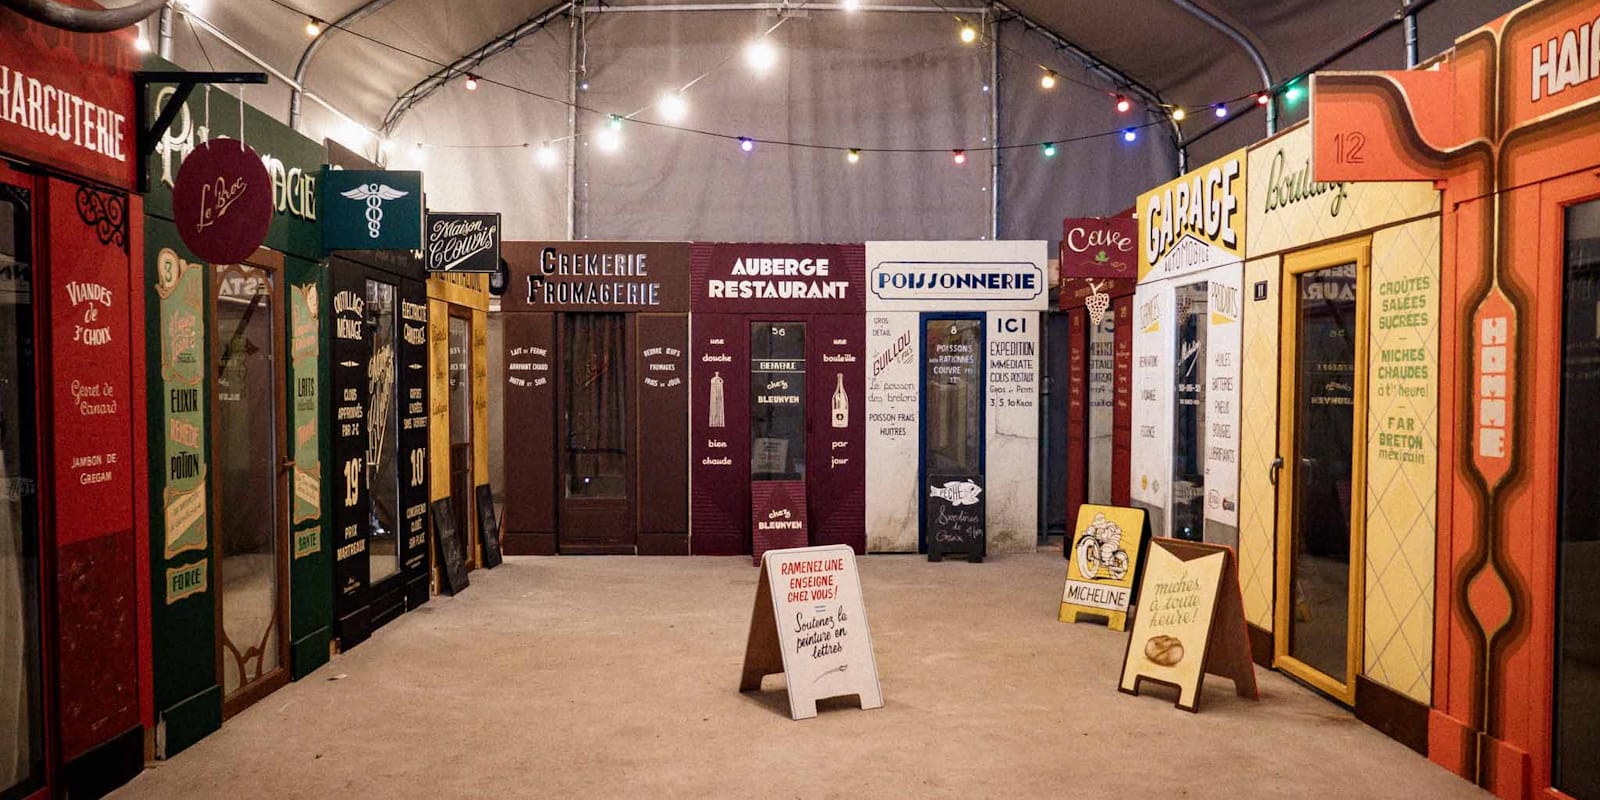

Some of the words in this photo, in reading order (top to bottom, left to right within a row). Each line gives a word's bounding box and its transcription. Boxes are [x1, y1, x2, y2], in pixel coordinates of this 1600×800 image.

[0, 65, 126, 161] HARCUTERIE
[1334, 132, 1366, 164] 12
[197, 183, 214, 234] Le
[214, 177, 248, 212] Broc
[1145, 159, 1241, 266] GARAGE
[430, 219, 484, 242] Maison
[1067, 227, 1134, 253] Cave
[1164, 241, 1209, 272] AUTOMOBILE
[164, 261, 173, 283] 3
[731, 257, 829, 276] AUBERGE
[708, 279, 850, 299] RESTAURANT
[878, 272, 1036, 290] POISSONNERIE
[1379, 274, 1430, 296] CROÛTES
[66, 281, 112, 307] VIANDES
[526, 274, 661, 305] FROMAGERIE
[1382, 294, 1427, 313] SALÉES
[84, 302, 98, 324] de
[873, 317, 889, 325] GROS
[1379, 311, 1429, 330] SUCRÉES
[772, 326, 786, 337] 56
[951, 325, 958, 335] 8
[997, 317, 1026, 334] ICI
[83, 326, 112, 345] CHOIX
[709, 337, 725, 346] une
[832, 337, 848, 346] une
[510, 347, 522, 357] LAIT
[529, 347, 548, 357] FERME
[873, 329, 912, 377] GUILLOU
[936, 344, 974, 353] POISSONS
[989, 341, 1035, 357] EXPEDITION
[1380, 347, 1425, 363] MICHES
[702, 353, 733, 363] douche
[989, 359, 1034, 369] IMMEDIATE
[532, 363, 548, 371] CHAUD
[933, 366, 961, 375] COUVRE
[1377, 365, 1428, 380] CHAUDES
[534, 376, 547, 387] SOIR
[767, 380, 789, 390] chez
[1010, 373, 1034, 383] POSTAUX
[1211, 377, 1233, 391] BATTERIES
[102, 382, 114, 397] de
[1481, 316, 1508, 459] HOMME
[757, 395, 800, 404] BLEUNVEN
[79, 400, 117, 416] Canard
[869, 413, 896, 422] POISSON
[897, 413, 915, 422] FRAIS
[1387, 416, 1415, 432] FAR
[707, 439, 728, 448] bien
[831, 440, 849, 451] par
[1379, 432, 1424, 451] BRETON
[71, 455, 103, 470] JAMBON
[106, 453, 118, 465] DE
[170, 451, 200, 480] POTION
[702, 455, 733, 466] chaude
[831, 455, 849, 469] jour
[80, 471, 113, 486] GREGAM
[768, 508, 792, 520] chez
[758, 521, 803, 531] BLEUNVEN
[781, 560, 823, 576] RAMENEZ
[824, 558, 844, 572] UNE
[172, 568, 202, 593] FORCE
[790, 575, 834, 589] ENSEIGNE
[1154, 574, 1200, 596] miches
[787, 589, 809, 603] CHEZ
[1067, 584, 1127, 607] MICHELINE
[1163, 593, 1200, 611] toute
[794, 611, 836, 633] Soutenez
[837, 604, 848, 623] la
[796, 631, 832, 654] peinture
[834, 627, 848, 638] en
[811, 641, 843, 660] lettres
